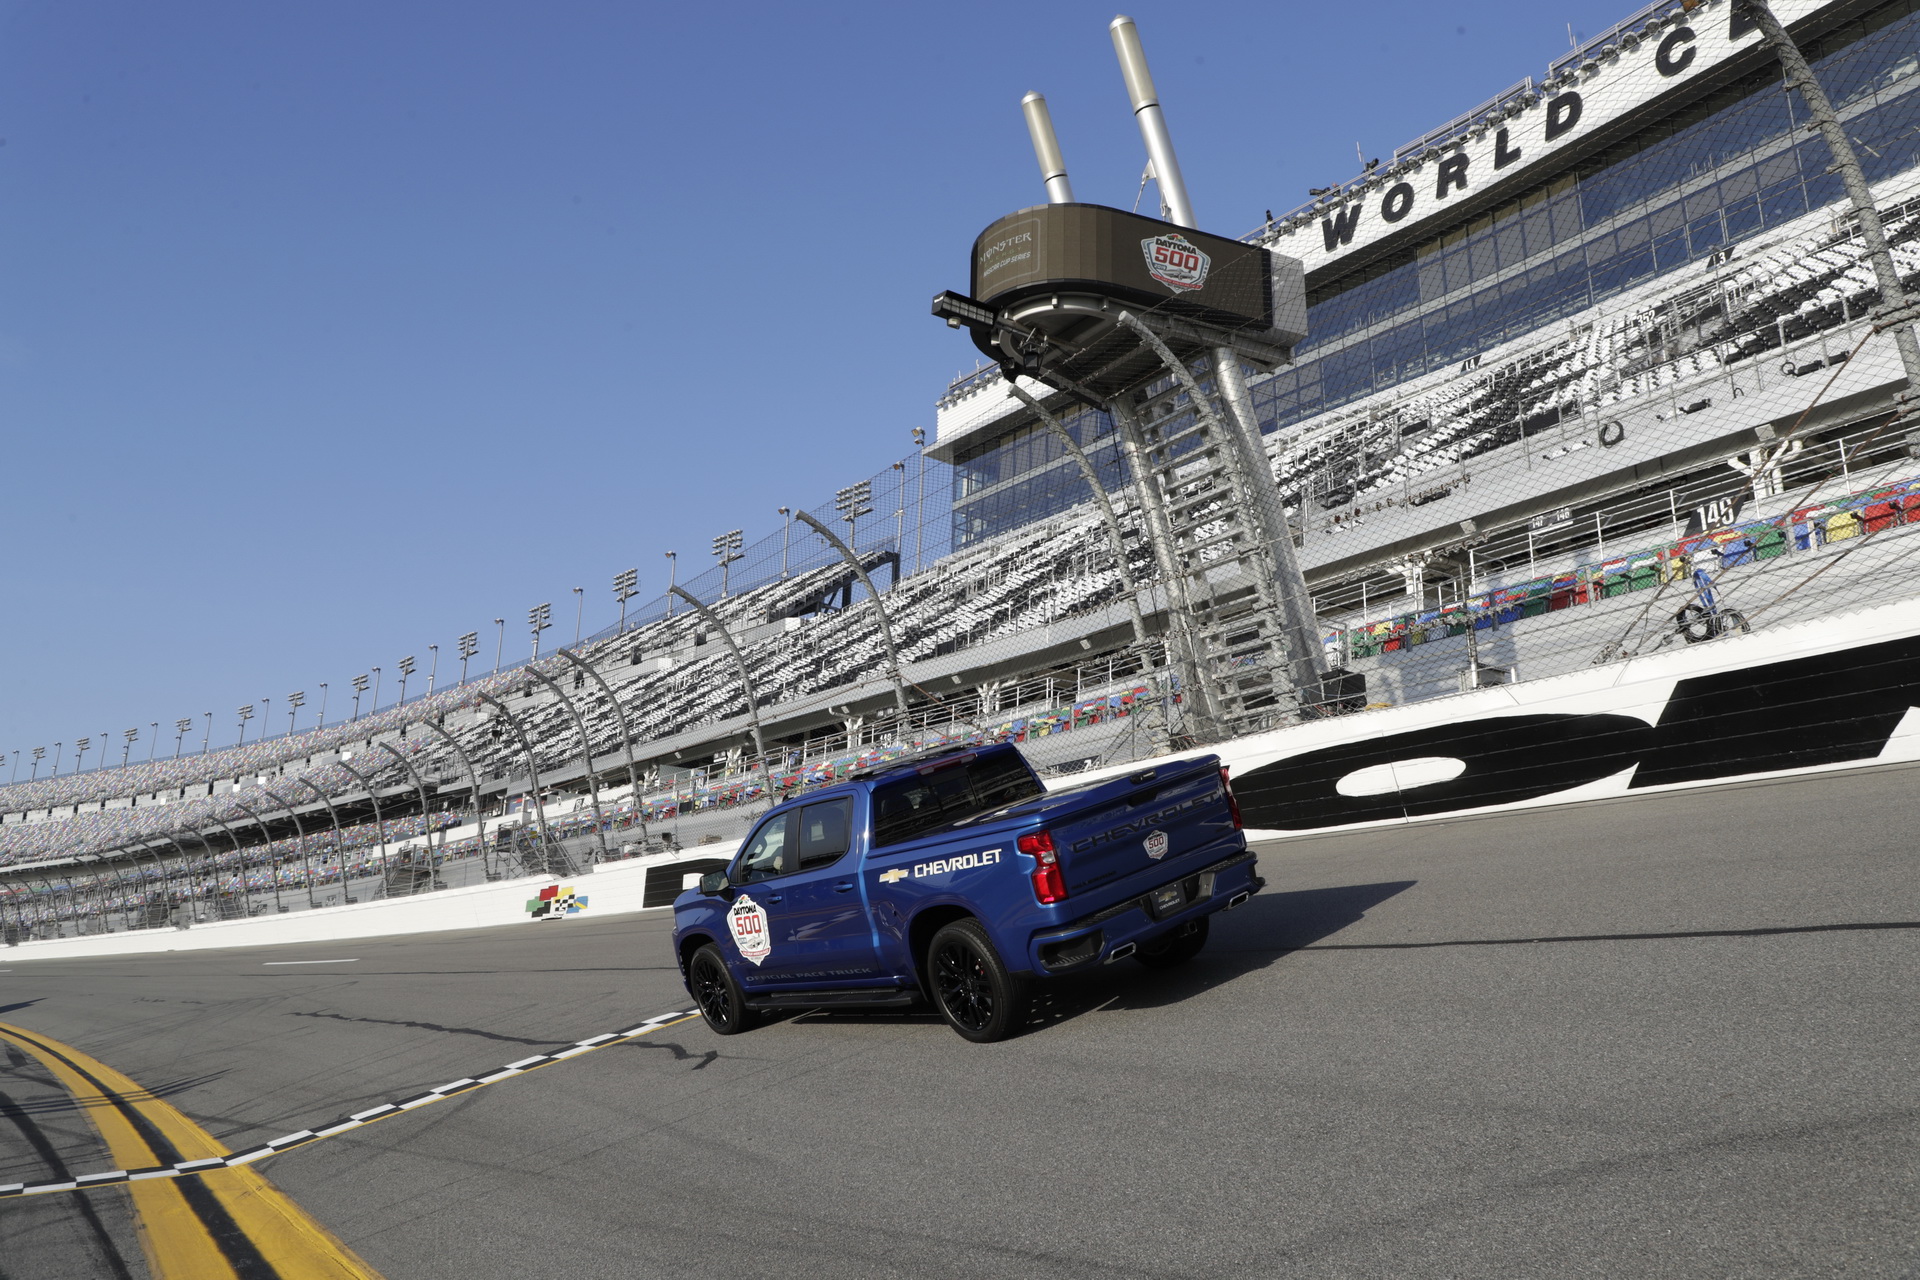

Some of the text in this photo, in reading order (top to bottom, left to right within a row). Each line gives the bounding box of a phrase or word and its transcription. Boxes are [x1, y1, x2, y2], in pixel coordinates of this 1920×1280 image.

[1322, 90, 1581, 253] WORLD
[979, 231, 1033, 264] MONSTER
[1155, 237, 1198, 256] DAYTONA
[1154, 246, 1200, 272] 500
[1072, 790, 1218, 854] CHEVROLET
[1148, 836, 1165, 849] 500
[914, 848, 1003, 878] CHEVROLET
[733, 904, 758, 917] DAYTONA
[735, 914, 762, 936] 500
[745, 967, 872, 982] OFFICIAL PACE TRUCK
